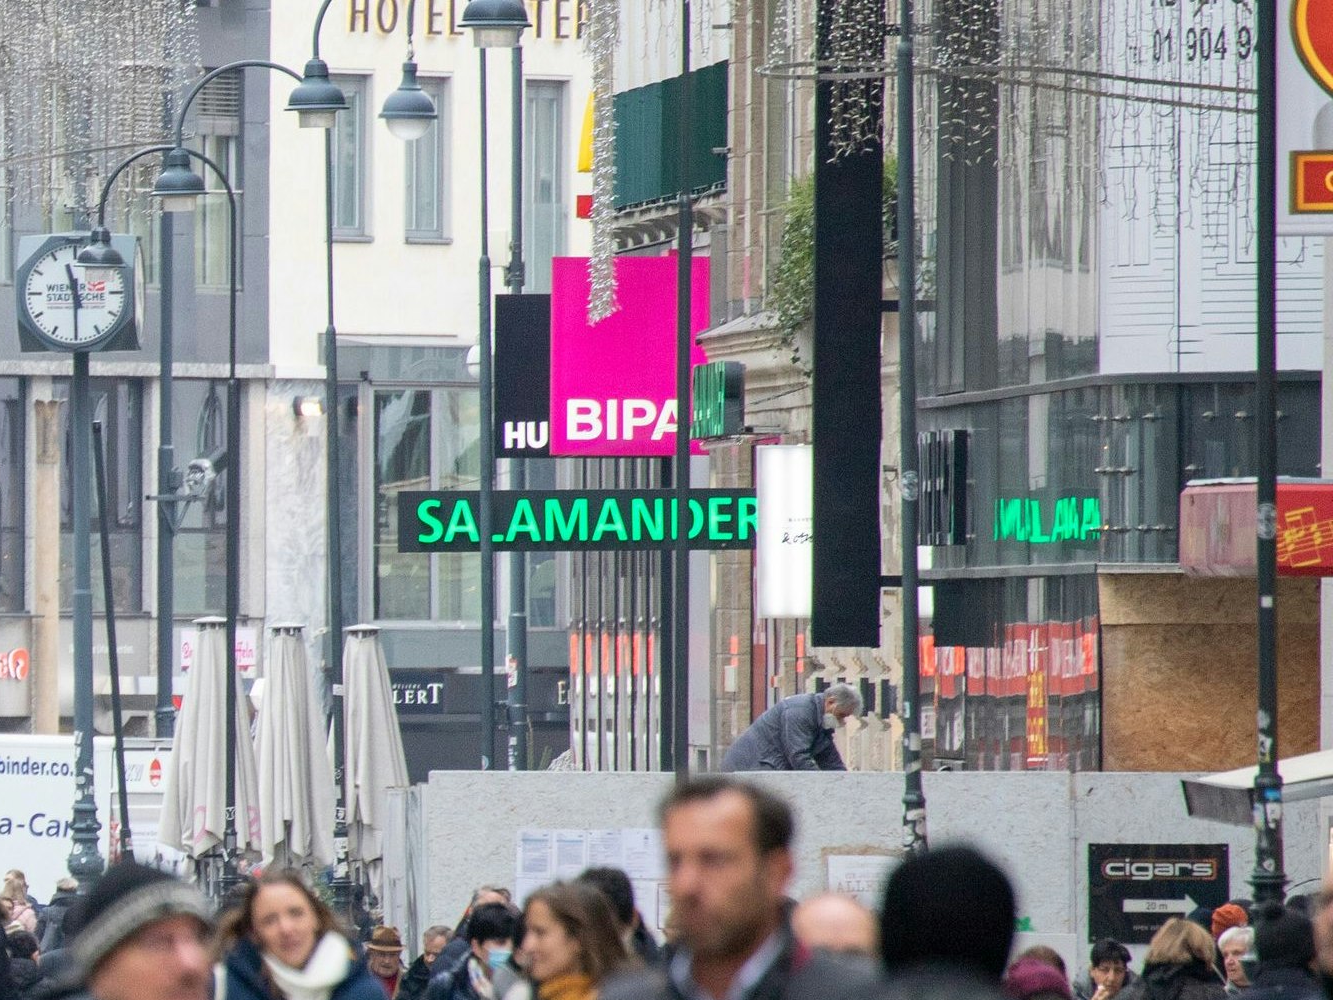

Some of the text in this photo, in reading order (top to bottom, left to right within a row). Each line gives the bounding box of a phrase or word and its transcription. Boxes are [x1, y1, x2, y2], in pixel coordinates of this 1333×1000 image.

[348, 0, 464, 36] HOEL
[1185, 26, 1228, 62] 904
[504, 420, 549, 449] HU
[565, 398, 678, 441] BIPA
[416, 497, 757, 544] SAAMANDER
[1105, 858, 1213, 881] cigars
[1145, 902, 1158, 910] 20
